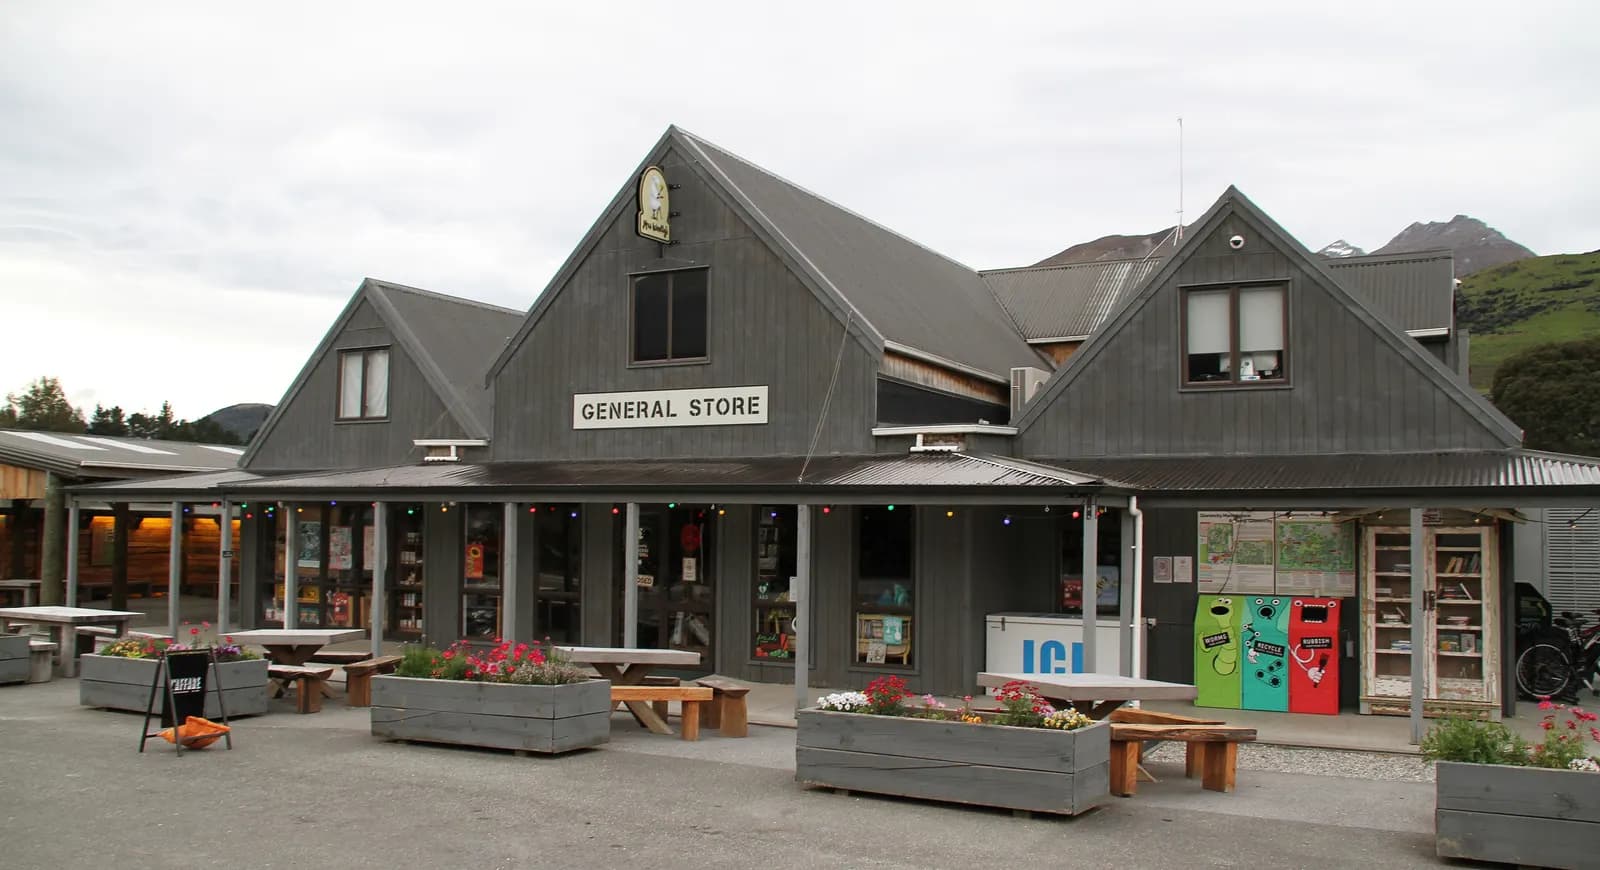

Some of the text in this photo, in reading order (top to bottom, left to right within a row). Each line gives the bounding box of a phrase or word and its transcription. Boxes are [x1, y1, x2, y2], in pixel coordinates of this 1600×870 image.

[582, 396, 760, 420] GENERAL STORE
[1204, 633, 1227, 645] WORMS
[1257, 642, 1282, 653] RECYCLE
